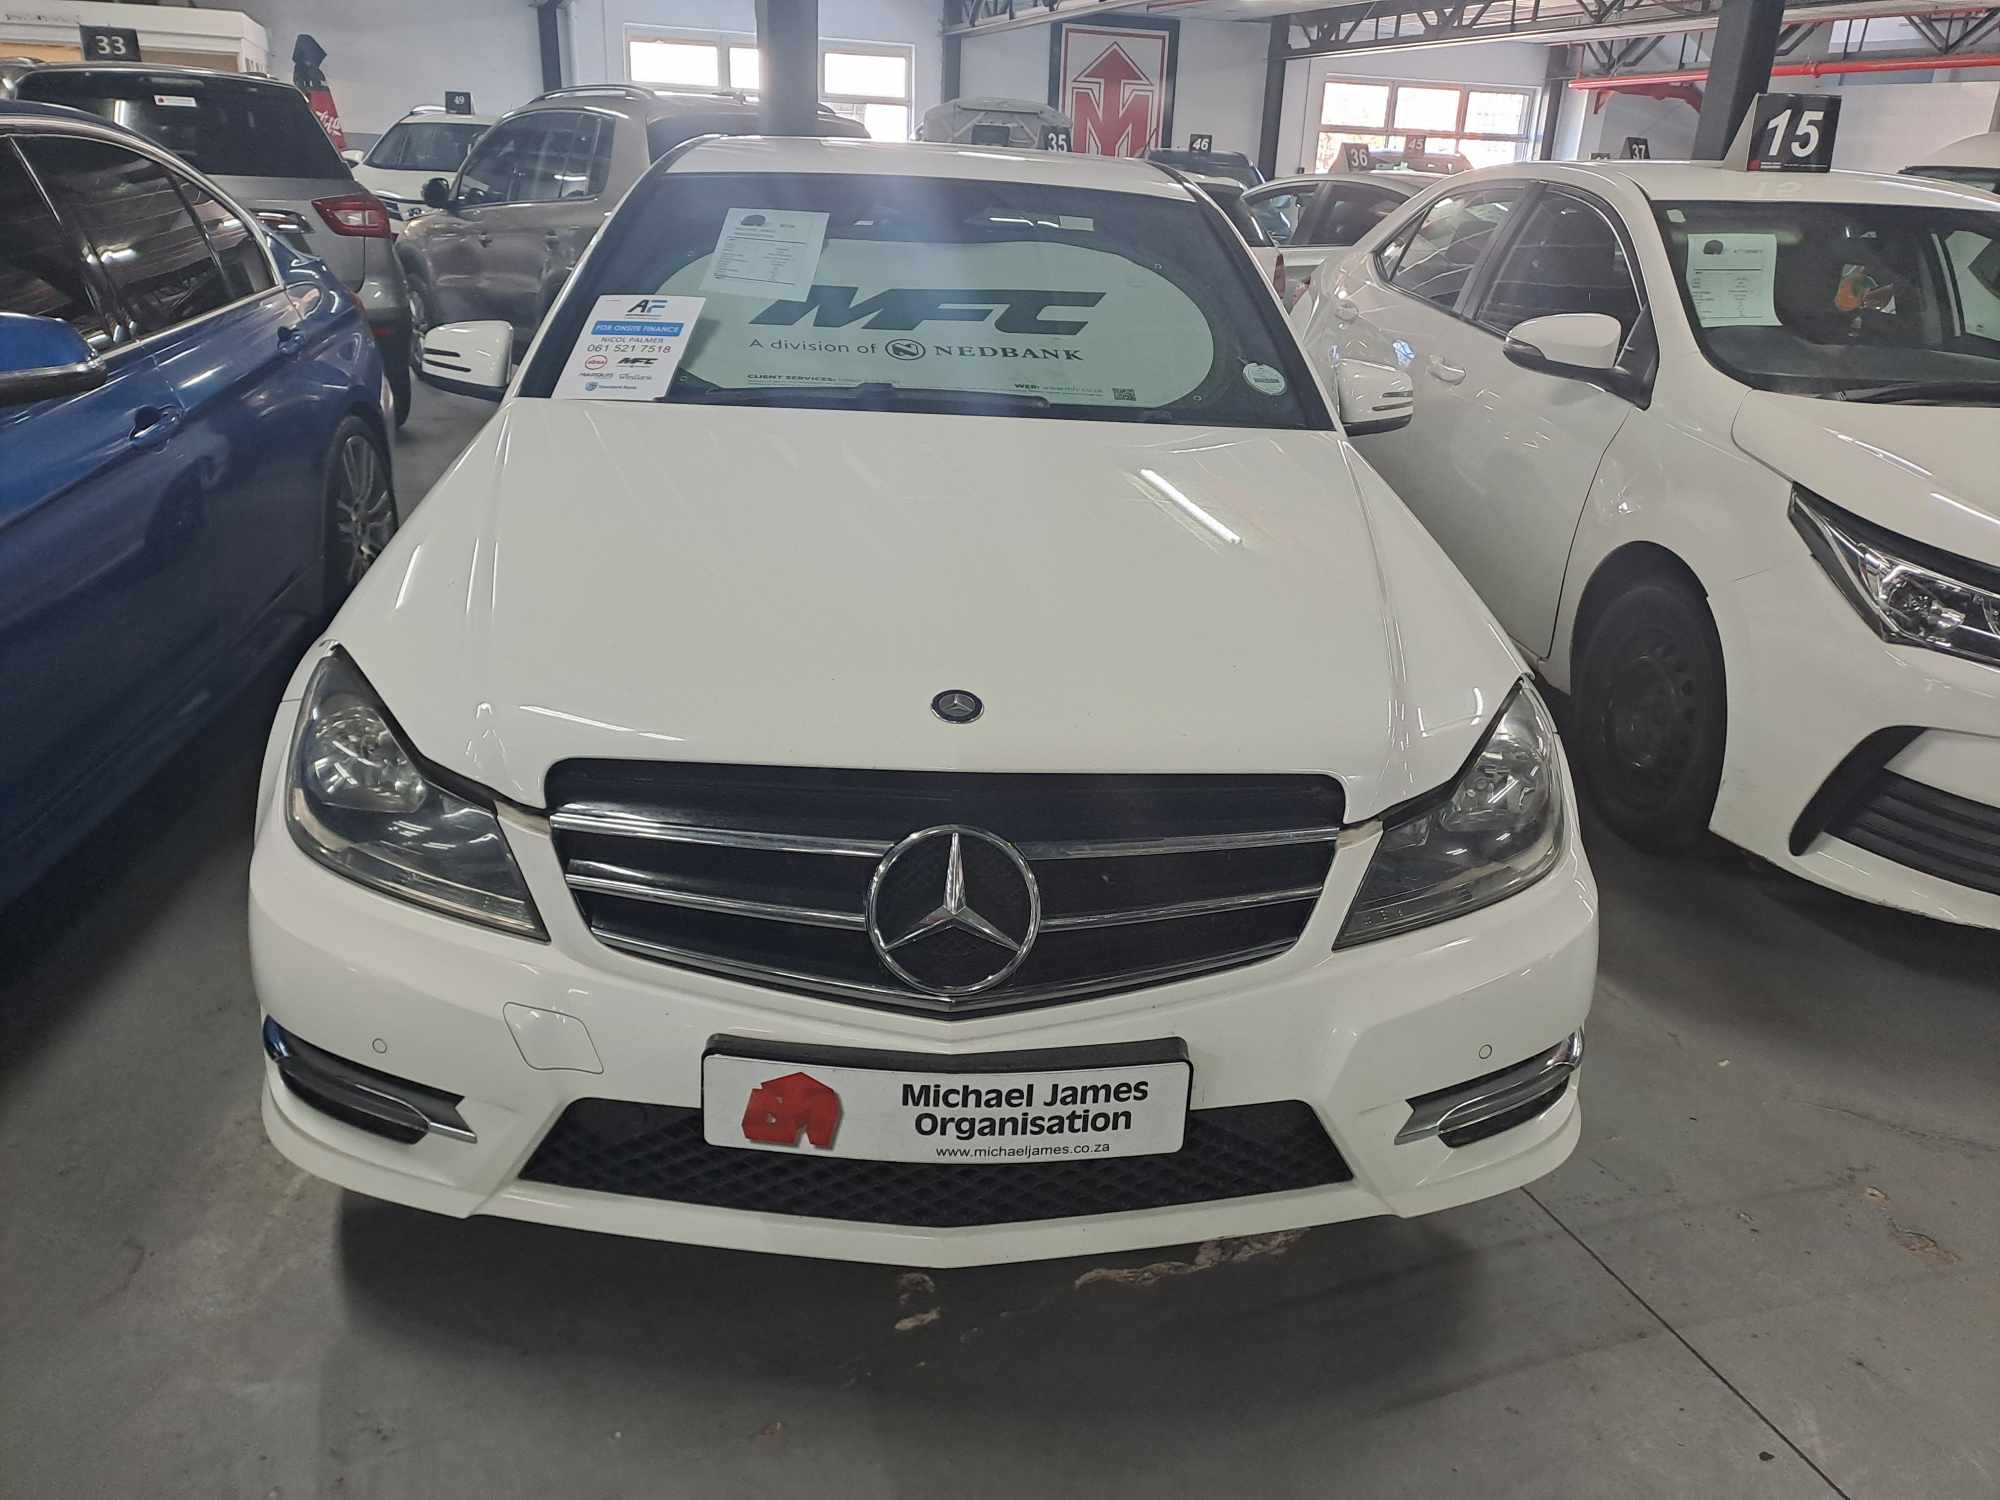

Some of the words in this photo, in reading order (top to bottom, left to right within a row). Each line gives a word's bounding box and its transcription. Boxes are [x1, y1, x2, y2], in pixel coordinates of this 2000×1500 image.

[95, 35, 127, 55] 33
[1047, 132, 1068, 153] 35
[1767, 108, 1824, 158] 15
[1192, 137, 1209, 150] 46
[1408, 138, 1424, 151] 45
[1632, 143, 1646, 160] 37
[1350, 148, 1368, 167] 36
[627, 299, 668, 313] AF
[748, 284, 1106, 336] MFC
[642, 326, 681, 335] FINANCE
[586, 343, 609, 352] 061
[613, 344, 636, 353] 521
[640, 345, 672, 354] 7518
[750, 338, 764, 348] A
[770, 339, 850, 353] division
[856, 343, 877, 354] of
[935, 345, 1084, 361] NEDBANK
[902, 1083, 1035, 1108] Michael
[1042, 1080, 1149, 1107] James
[914, 1109, 1132, 1141] Organisation
[935, 1143, 1111, 1158] www.michaeljames.co.za
